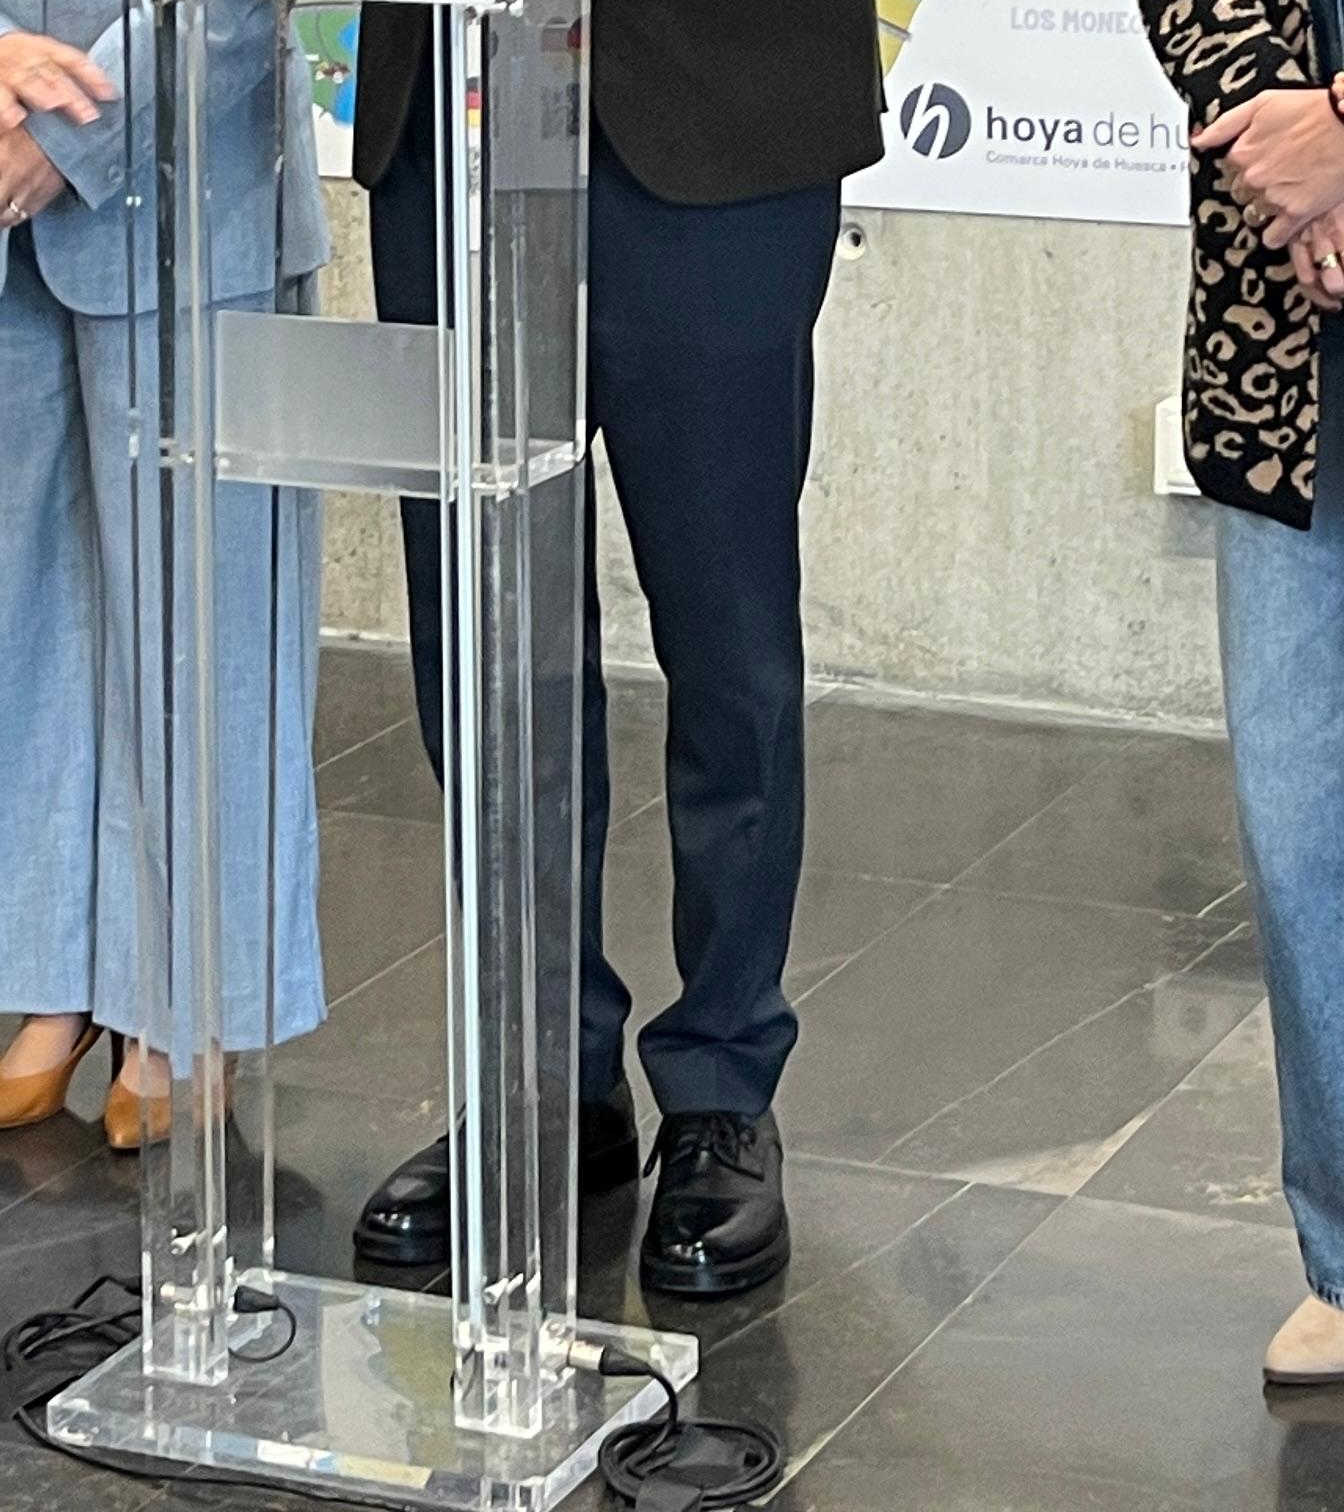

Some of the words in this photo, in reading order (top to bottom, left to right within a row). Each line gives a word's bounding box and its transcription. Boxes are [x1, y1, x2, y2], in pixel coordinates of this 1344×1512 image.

[1010, 7, 1055, 30] LOS
[986, 106, 1083, 151] hoya
[1093, 112, 1139, 148] de
[986, 150, 1048, 166] Comarca
[1052, 154, 1088, 169] Hoya
[1093, 157, 1110, 169] de
[1115, 157, 1166, 172] Huesca
